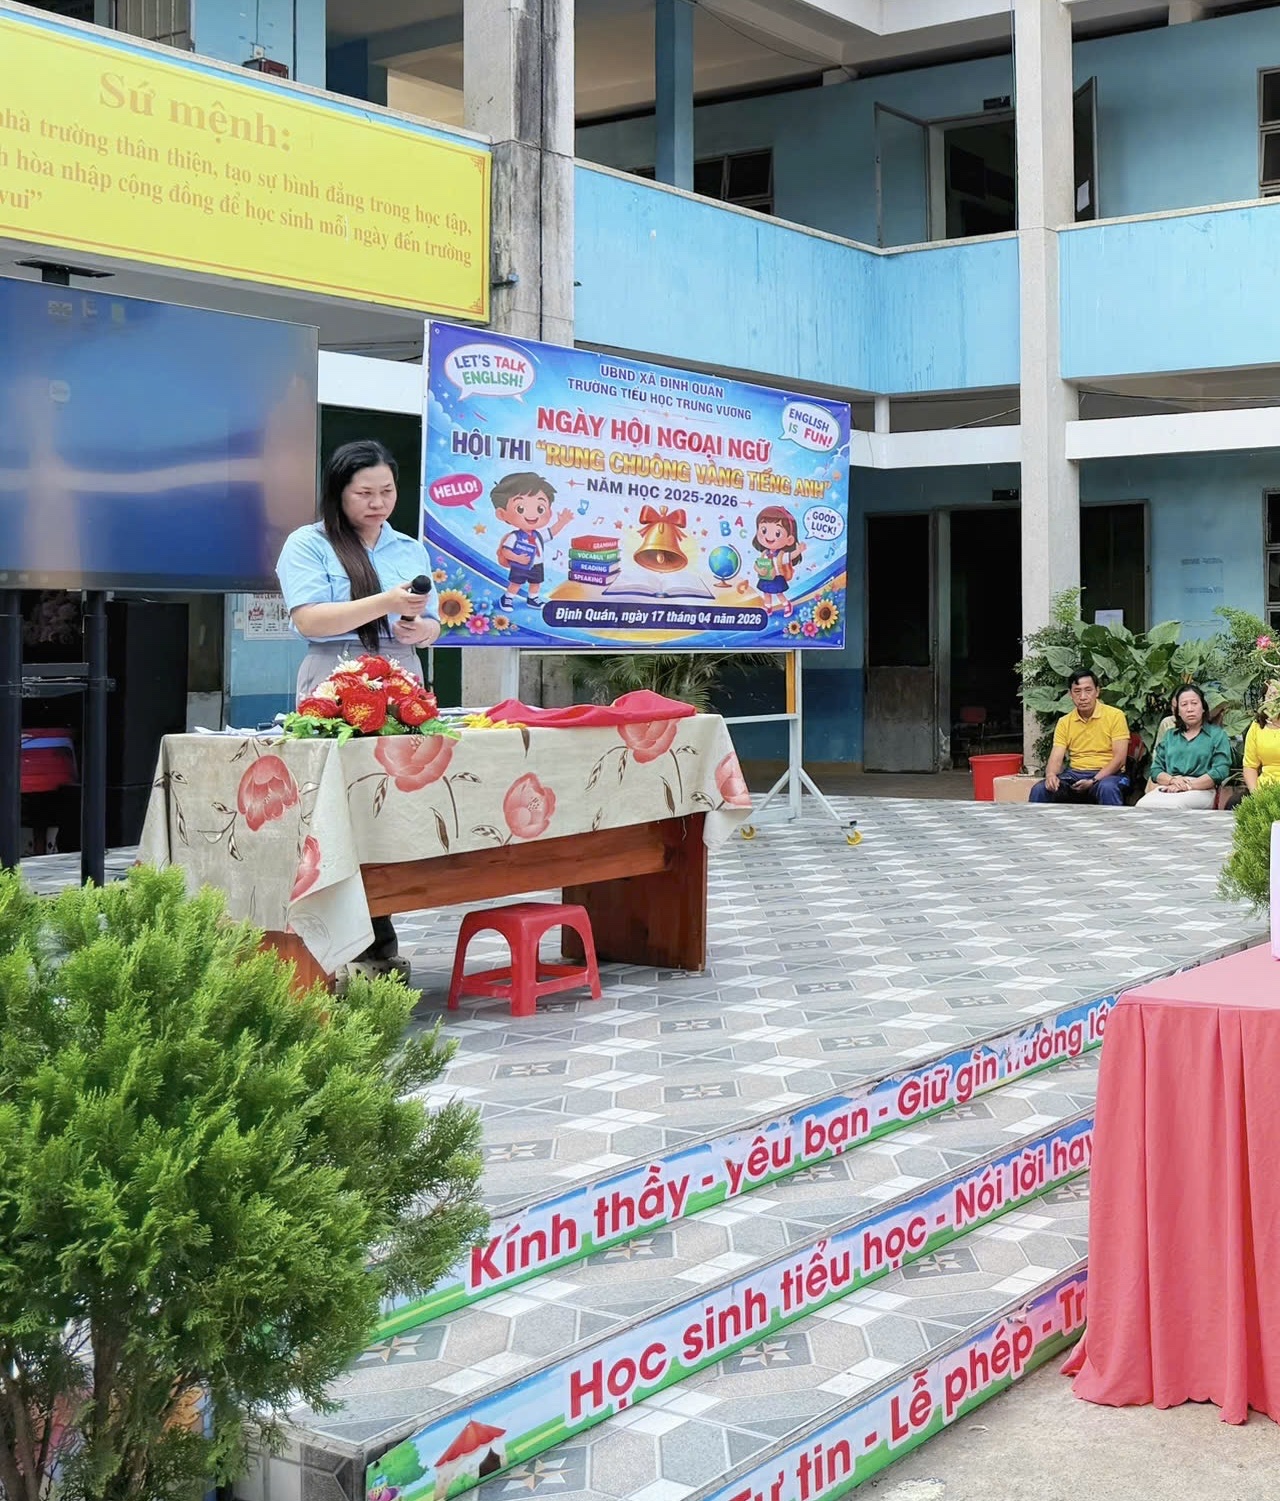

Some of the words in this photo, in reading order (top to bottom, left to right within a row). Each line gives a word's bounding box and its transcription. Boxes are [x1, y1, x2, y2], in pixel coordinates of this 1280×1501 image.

[99, 72, 156, 116] Sứ
[168, 100, 290, 151] mệnh:
[40, 118, 109, 156] trường
[117, 136, 159, 162] thân
[167, 147, 218, 178] thiện,
[225, 161, 252, 186] tạo
[258, 173, 278, 194] sự
[283, 173, 319, 199] bình
[326, 181, 365, 213] đẳng
[370, 195, 411, 223] trong
[415, 204, 440, 229] học
[445, 212, 472, 236] tập,
[16, 147, 54, 177] hòa
[61, 160, 112, 193] nhập
[118, 173, 163, 205] cộng
[168, 180, 214, 215] đồng
[219, 191, 241, 215] để
[245, 198, 275, 226] học
[280, 207, 314, 230] sinh
[319, 214, 348, 238] mỗi
[354, 225, 389, 250] ngày
[394, 230, 420, 253] đến
[425, 239, 472, 268] trường
[454, 354, 490, 369] LET'S
[494, 355, 527, 374] TALK
[462, 371, 524, 388] ENGLISH!
[600, 365, 636, 382] UBND
[639, 371, 656, 386] XÃ
[660, 376, 689, 393] ĐỊNH
[692, 382, 724, 398] QUÁN
[567, 378, 617, 397] TRƯỜNG
[620, 385, 647, 402] TIỂU
[650, 394, 673, 408] HỌC
[675, 397, 713, 414] TRƯNG
[716, 404, 752, 420] VƯƠNG
[537, 407, 604, 438] NGÀY
[611, 417, 651, 447] HỘI
[657, 426, 722, 458] NGOẠI
[728, 438, 771, 462] NGỮ
[788, 422, 798, 434] IS
[804, 427, 833, 448] FUN!
[789, 408, 830, 433] ENGLISH
[452, 428, 491, 460] HỘI
[497, 436, 531, 461] THI
[609, 452, 692, 483] CHUÔNG
[694, 459, 744, 490] VÀNG
[747, 467, 792, 496] TIẾNG
[433, 480, 478, 499] HELLO!
[587, 476, 623, 494] NĂM
[628, 483, 660, 501] HỌC
[664, 487, 738, 508] 2025-2026
[811, 522, 837, 536] LUCK!
[812, 511, 836, 524] GOOD
[573, 573, 603, 584] SPEAKING
[580, 563, 608, 573] READING
[555, 607, 582, 623] Định
[585, 608, 619, 623] Quán,
[621, 611, 649, 625] ngày
[651, 610, 663, 622] 17
[666, 611, 697, 626] tháng
[698, 613, 711, 624] 04
[713, 612, 735, 624] năm
[736, 613, 762, 625] 2026
[471, 1213, 577, 1288] Kính
[593, 1164, 690, 1238] thầy
[725, 1135, 792, 1195] yêu
[804, 1107, 868, 1156] bạn
[897, 1069, 950, 1116] Giữ
[956, 1051, 997, 1104] gìn
[570, 1342, 666, 1419] Học
[683, 1287, 767, 1360] sinh
[780, 1239, 850, 1310] tiểu
[863, 1216, 927, 1269] học
[955, 1170, 1002, 1225] Nói
[1012, 1149, 1044, 1196] lời
[796, 1439, 850, 1501] tin
[890, 1369, 932, 1443] Lễ
[944, 1325, 1033, 1416] phép
